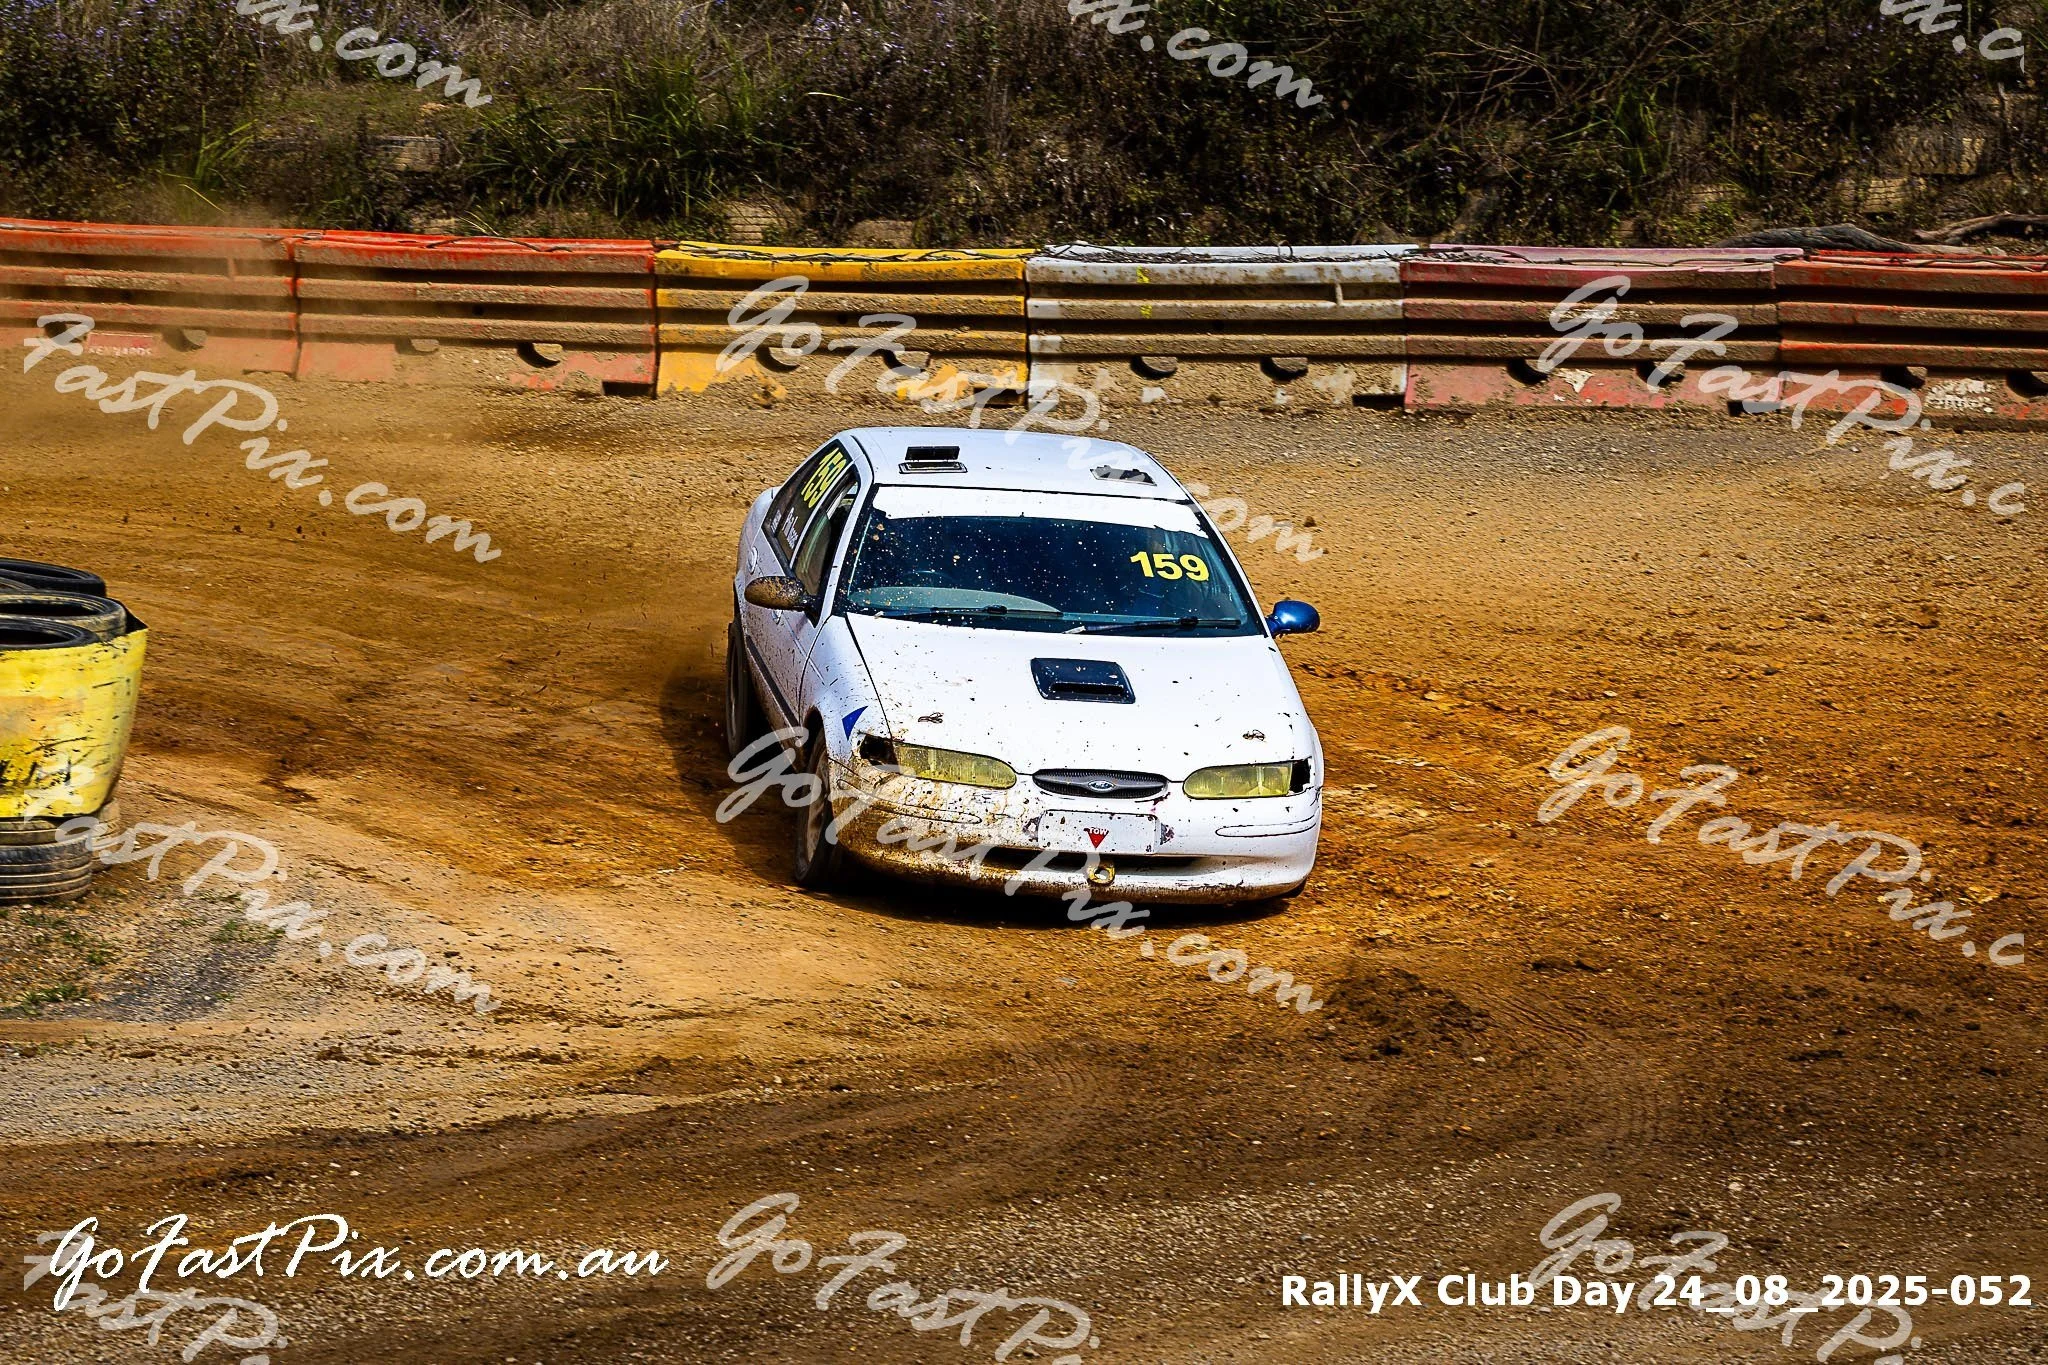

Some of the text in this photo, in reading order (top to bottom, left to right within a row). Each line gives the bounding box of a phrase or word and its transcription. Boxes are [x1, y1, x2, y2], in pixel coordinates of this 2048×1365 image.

[800, 446, 847, 509] 159
[1129, 551, 1210, 581] 159
[1088, 826, 1110, 836] TOW
